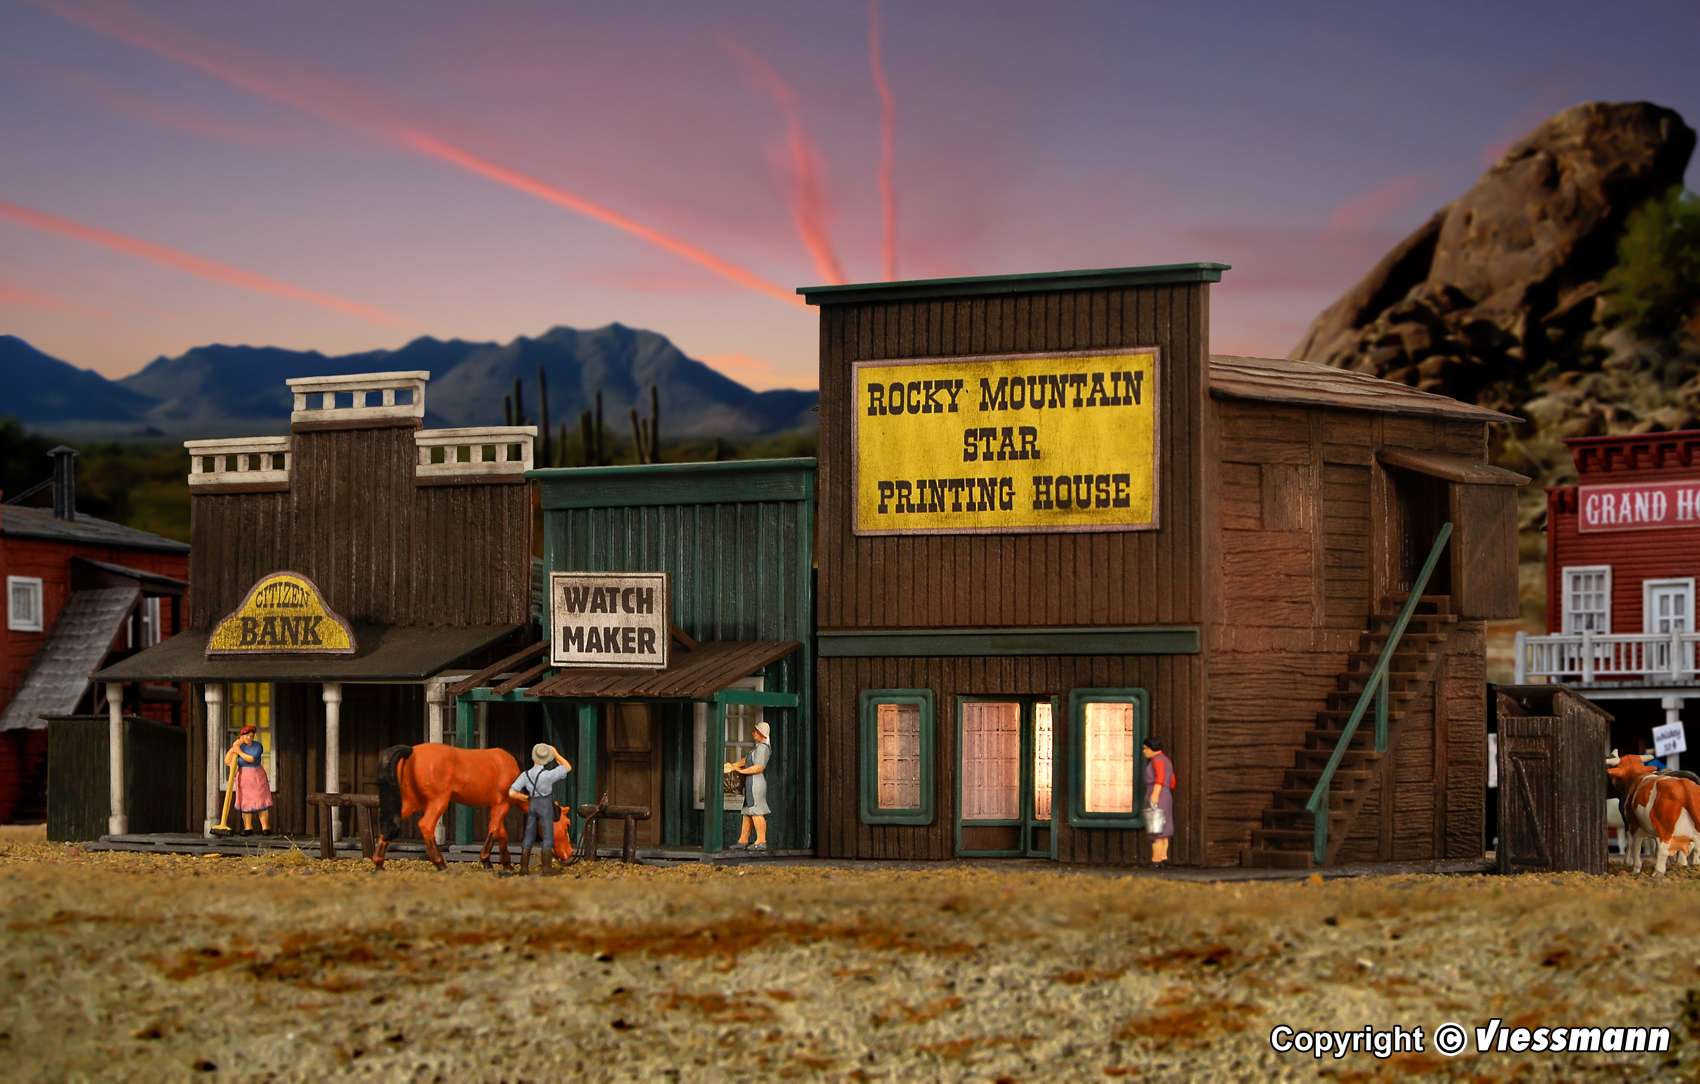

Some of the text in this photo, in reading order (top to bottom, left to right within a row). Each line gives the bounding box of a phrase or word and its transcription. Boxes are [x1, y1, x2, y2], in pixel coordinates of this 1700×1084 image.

[867, 370, 1144, 416] ROCKY MOUNTAIN
[963, 426, 1041, 462] STAR
[877, 473, 1131, 514] PRINTING HOUSE
[1585, 490, 1667, 525] GRAND
[255, 581, 310, 608] CITIZEN
[563, 586, 654, 614] WATCH
[239, 616, 323, 646] BANK
[562, 626, 657, 654] MAKER
